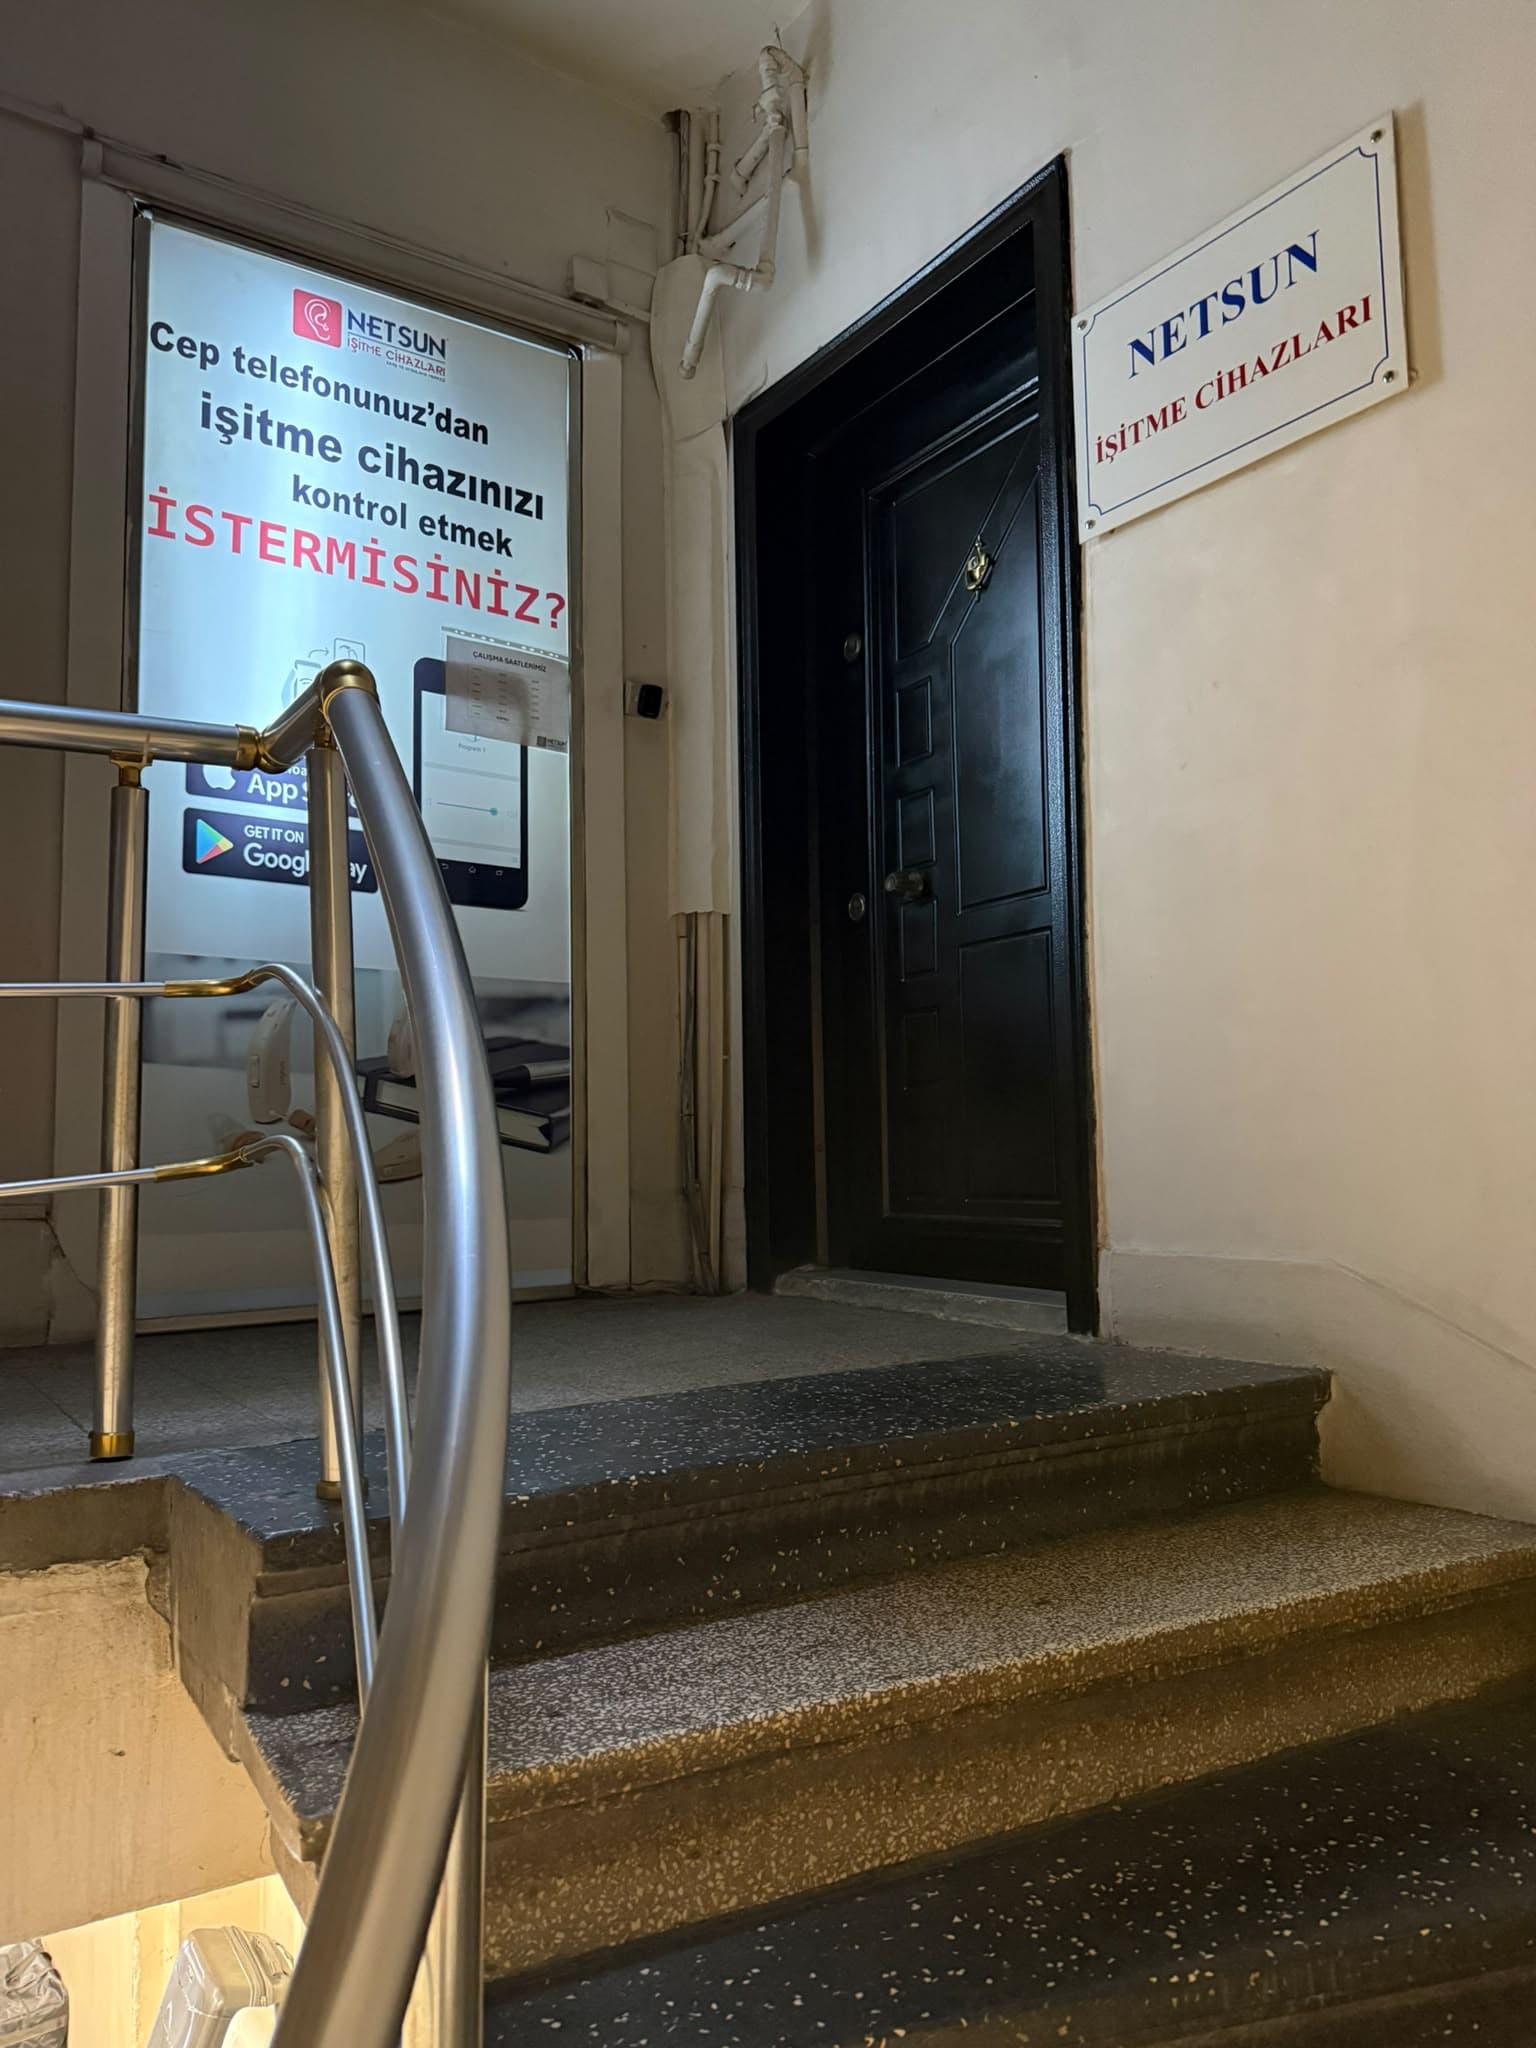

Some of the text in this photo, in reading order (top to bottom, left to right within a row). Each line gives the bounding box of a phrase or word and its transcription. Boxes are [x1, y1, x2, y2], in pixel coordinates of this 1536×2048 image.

[1127, 229, 1320, 380] NETSUN
[150, 320, 220, 371] Cep
[347, 308, 446, 360] NETSUN
[385, 350, 446, 377] CİHAZLARI
[1095, 295, 1372, 465] İŞİTME CİHAZLARI
[200, 391, 544, 521] işitme cihazınızı
[292, 474, 513, 559] kontrol etmek
[147, 486, 566, 629] İSTERMİSİNİZ?
[247, 773, 298, 804] App
[243, 842, 310, 878] Googl
[244, 825, 304, 844] GET IT ON
